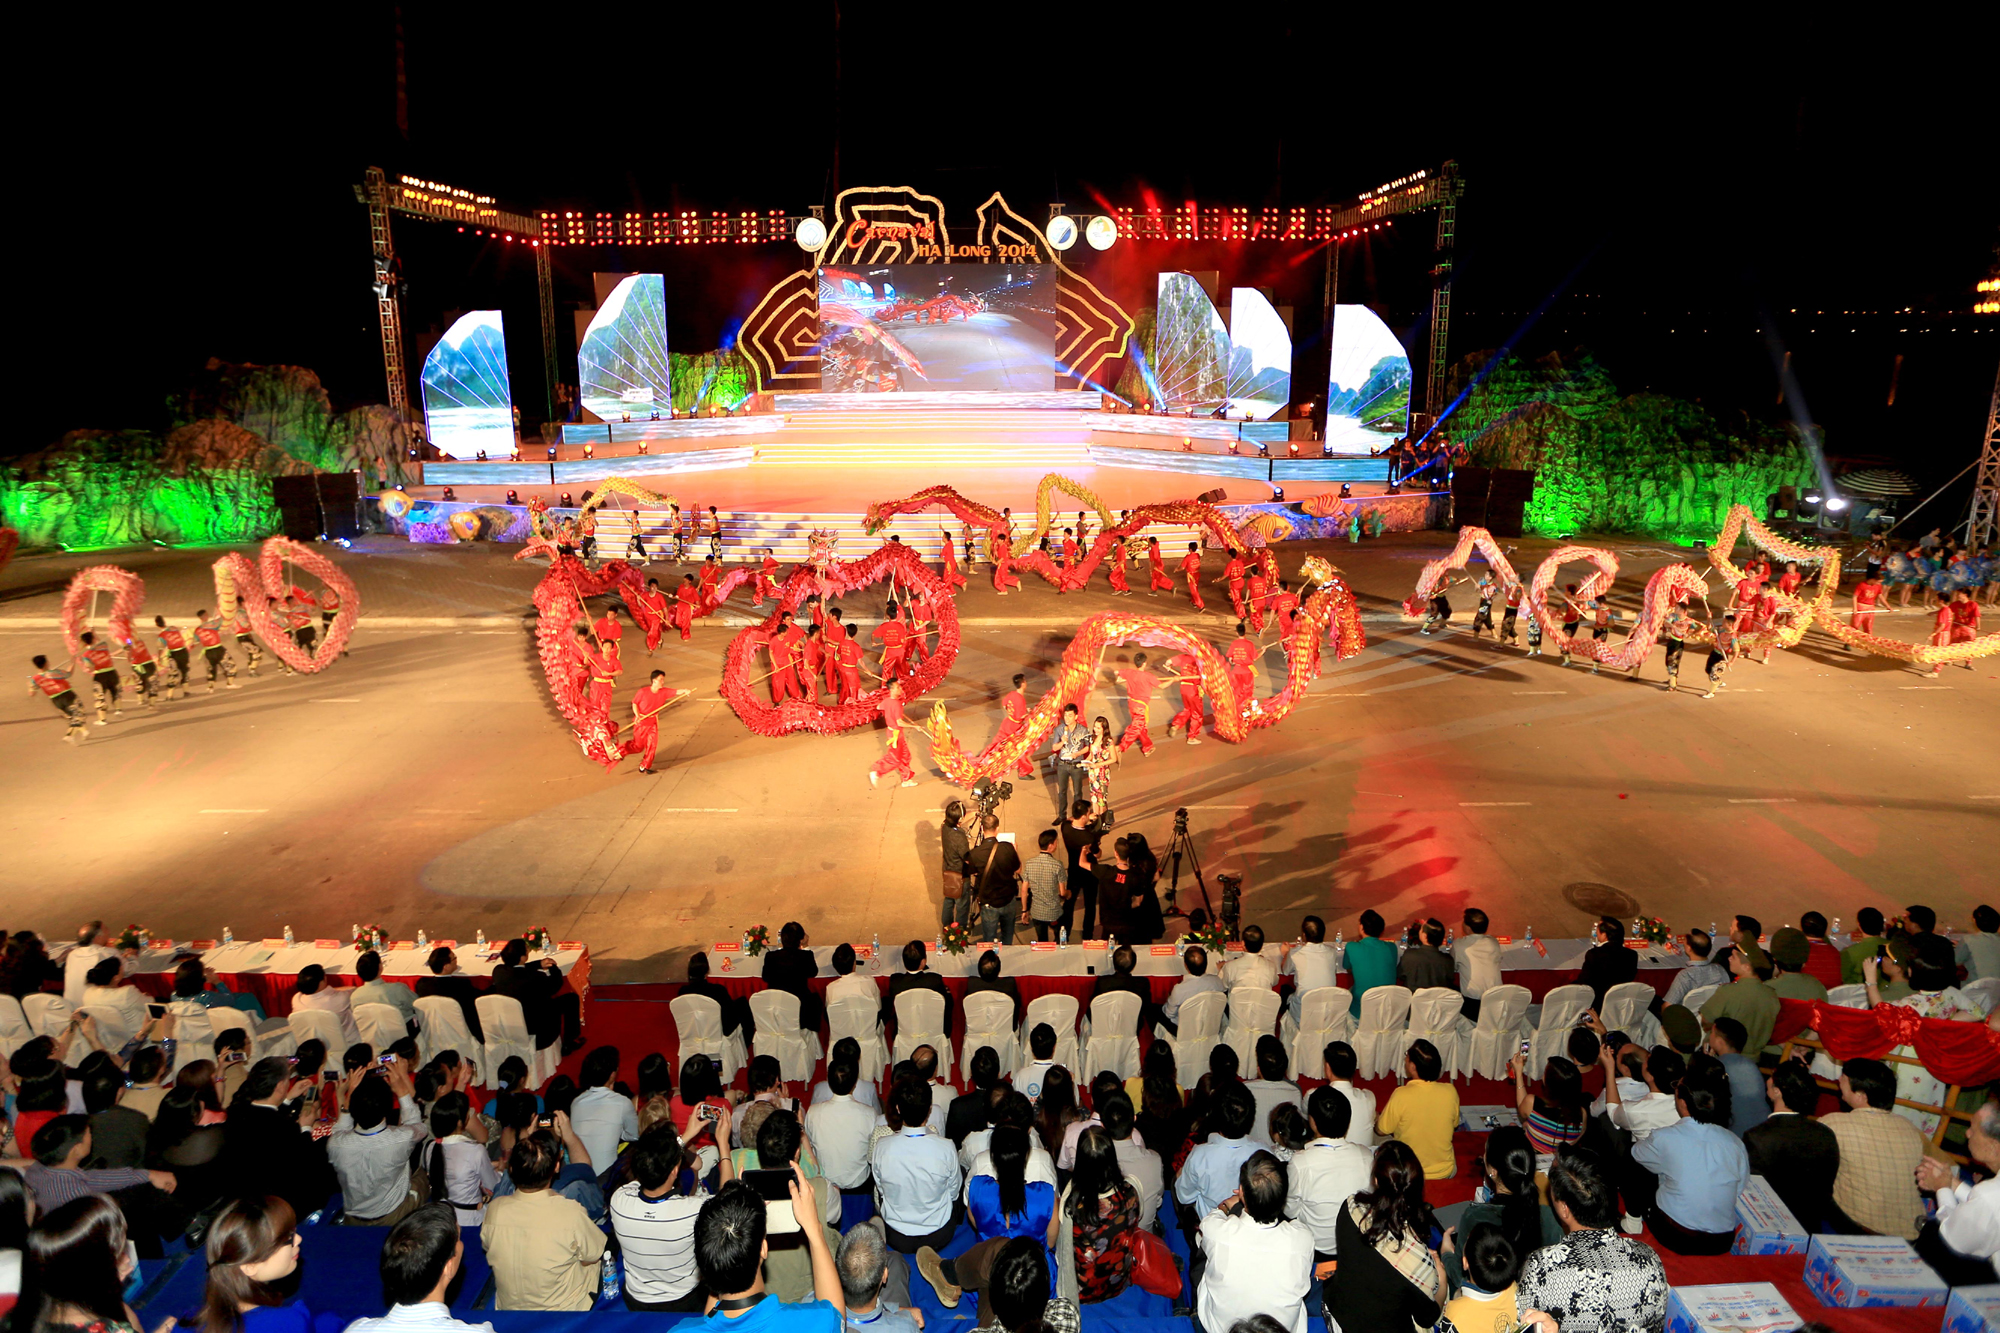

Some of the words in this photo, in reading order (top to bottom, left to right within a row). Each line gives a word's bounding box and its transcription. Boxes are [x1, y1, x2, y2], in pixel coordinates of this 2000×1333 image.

[846, 219, 936, 248] Carnaval
[918, 244, 942, 259] HẠ
[950, 244, 991, 257] LONG
[998, 244, 1037, 257] 2014
